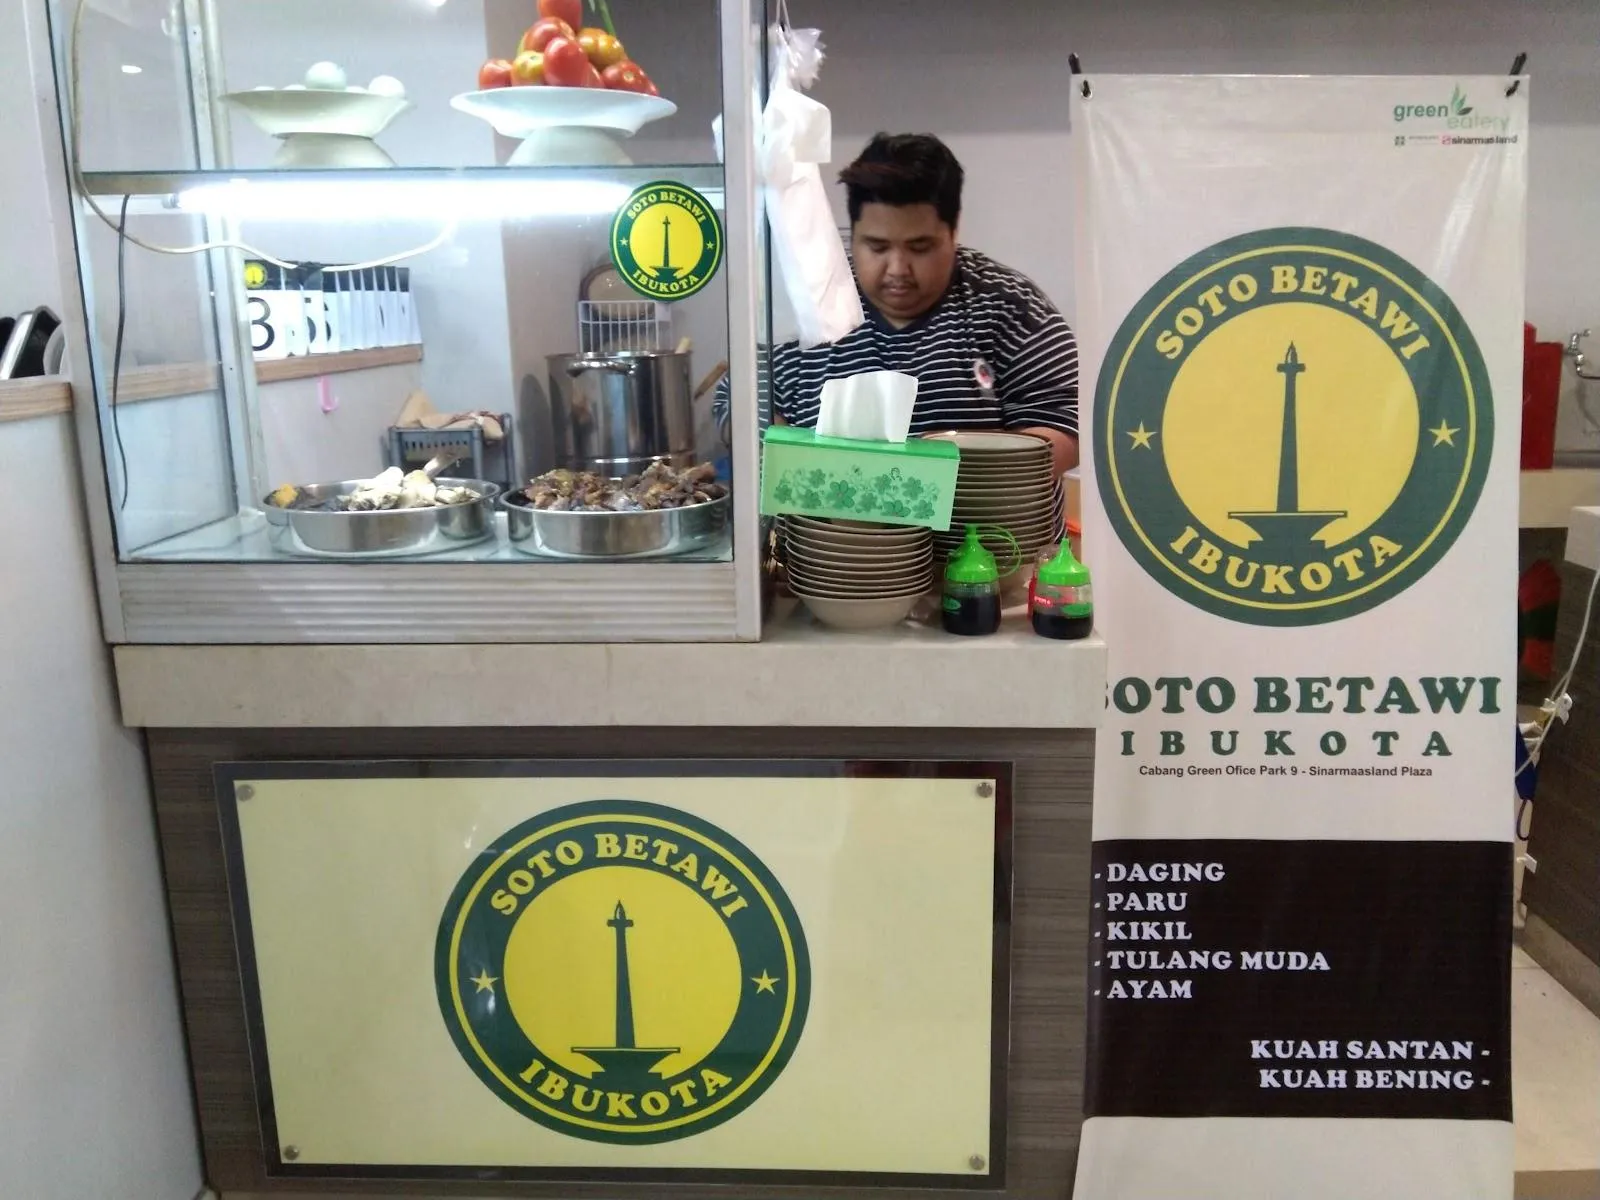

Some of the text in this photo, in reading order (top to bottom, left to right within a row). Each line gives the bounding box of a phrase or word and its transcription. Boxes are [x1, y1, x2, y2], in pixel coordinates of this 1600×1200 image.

[1393, 104, 1449, 121] green
[1446, 110, 1510, 130] eatery
[627, 191, 707, 223] SOTO BETAWI
[633, 269, 699, 293] IBUKOTA
[1156, 265, 1430, 360] SOTO BETAWI
[1170, 526, 1403, 594] IBUKOTA
[1105, 676, 1501, 714] OTO BETAWI
[1139, 765, 1184, 777] Cabang
[1187, 765, 1222, 776] Green
[1225, 765, 1256, 776] Ofice
[1260, 765, 1287, 776] Park
[1291, 766, 1298, 776] 9
[1309, 766, 1398, 777] Sinarmaasland
[1401, 766, 1433, 777] Plaza
[490, 833, 749, 918] SOTO BETAWI
[1107, 863, 1225, 882] DAGING
[1107, 893, 1187, 911] PARU
[1107, 922, 1192, 940] KIKIL
[1107, 951, 1232, 970] TULANG
[1240, 952, 1330, 971] MUDA
[1107, 980, 1192, 999] AYAM
[1251, 1040, 1338, 1059] KUAH
[1346, 1040, 1473, 1060] SANTAN
[519, 1059, 732, 1119] IBUKOTA
[1259, 1069, 1347, 1089] KUAH
[1355, 1070, 1474, 1089] BENING
